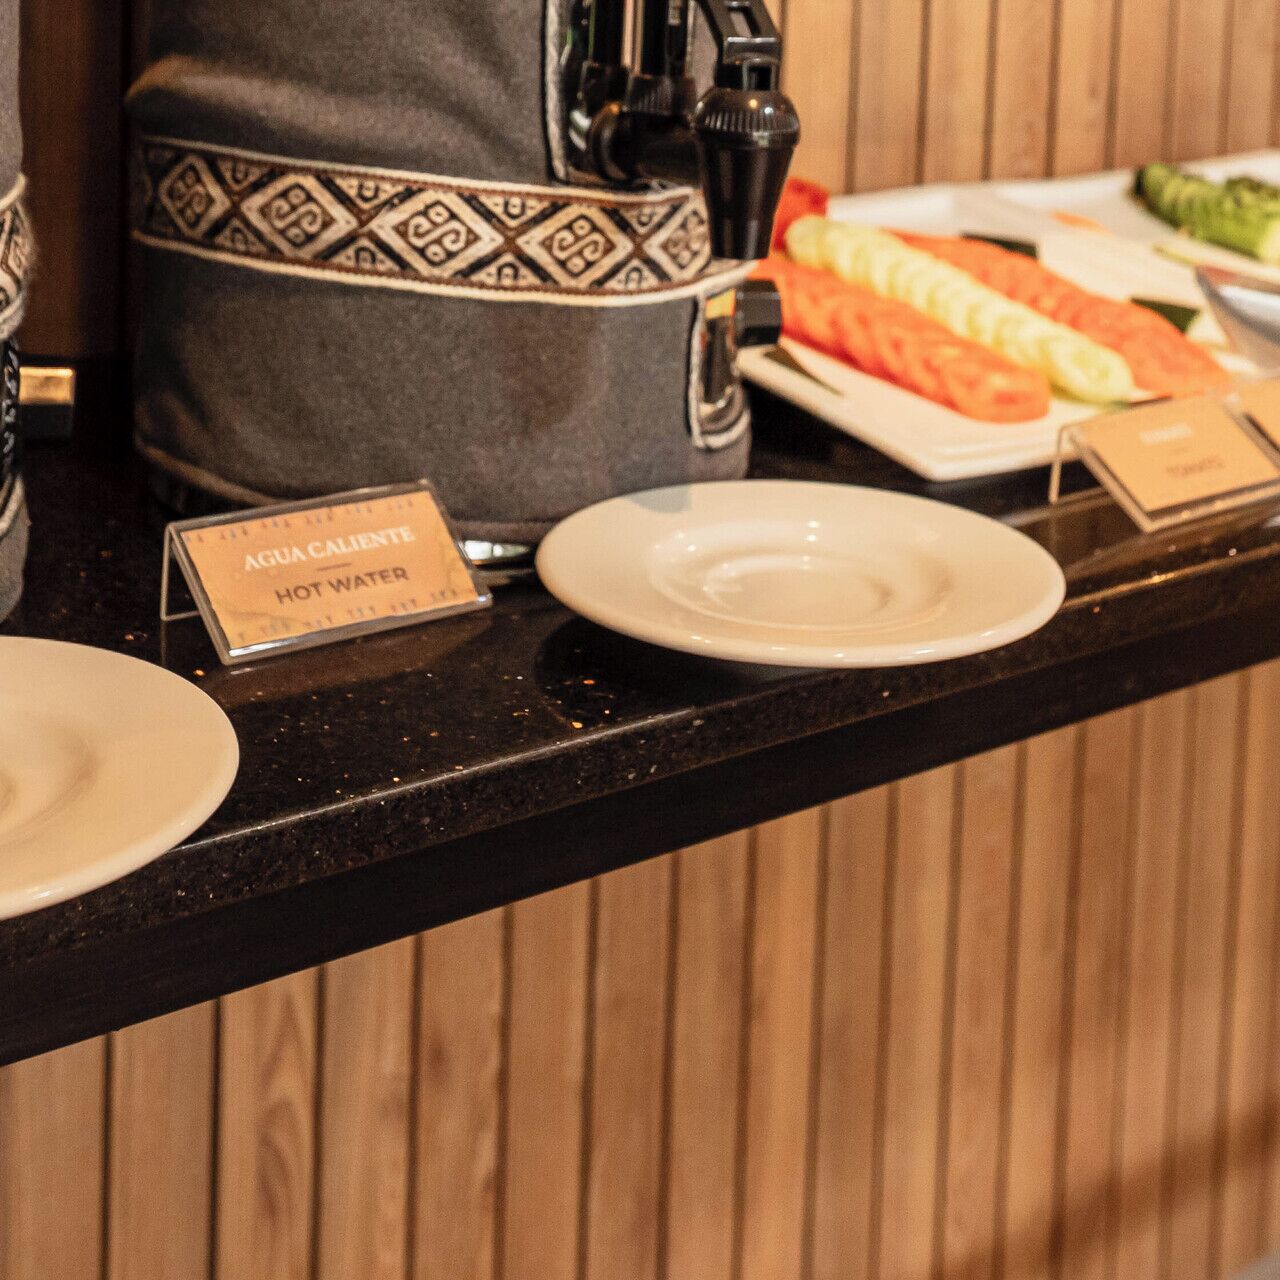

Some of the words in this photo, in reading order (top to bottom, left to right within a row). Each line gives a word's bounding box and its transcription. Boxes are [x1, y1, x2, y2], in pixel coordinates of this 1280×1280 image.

[244, 542, 306, 572] AGUA
[307, 525, 416, 559] CALIENTE
[274, 580, 321, 605] HOT
[329, 566, 410, 594] WATER
